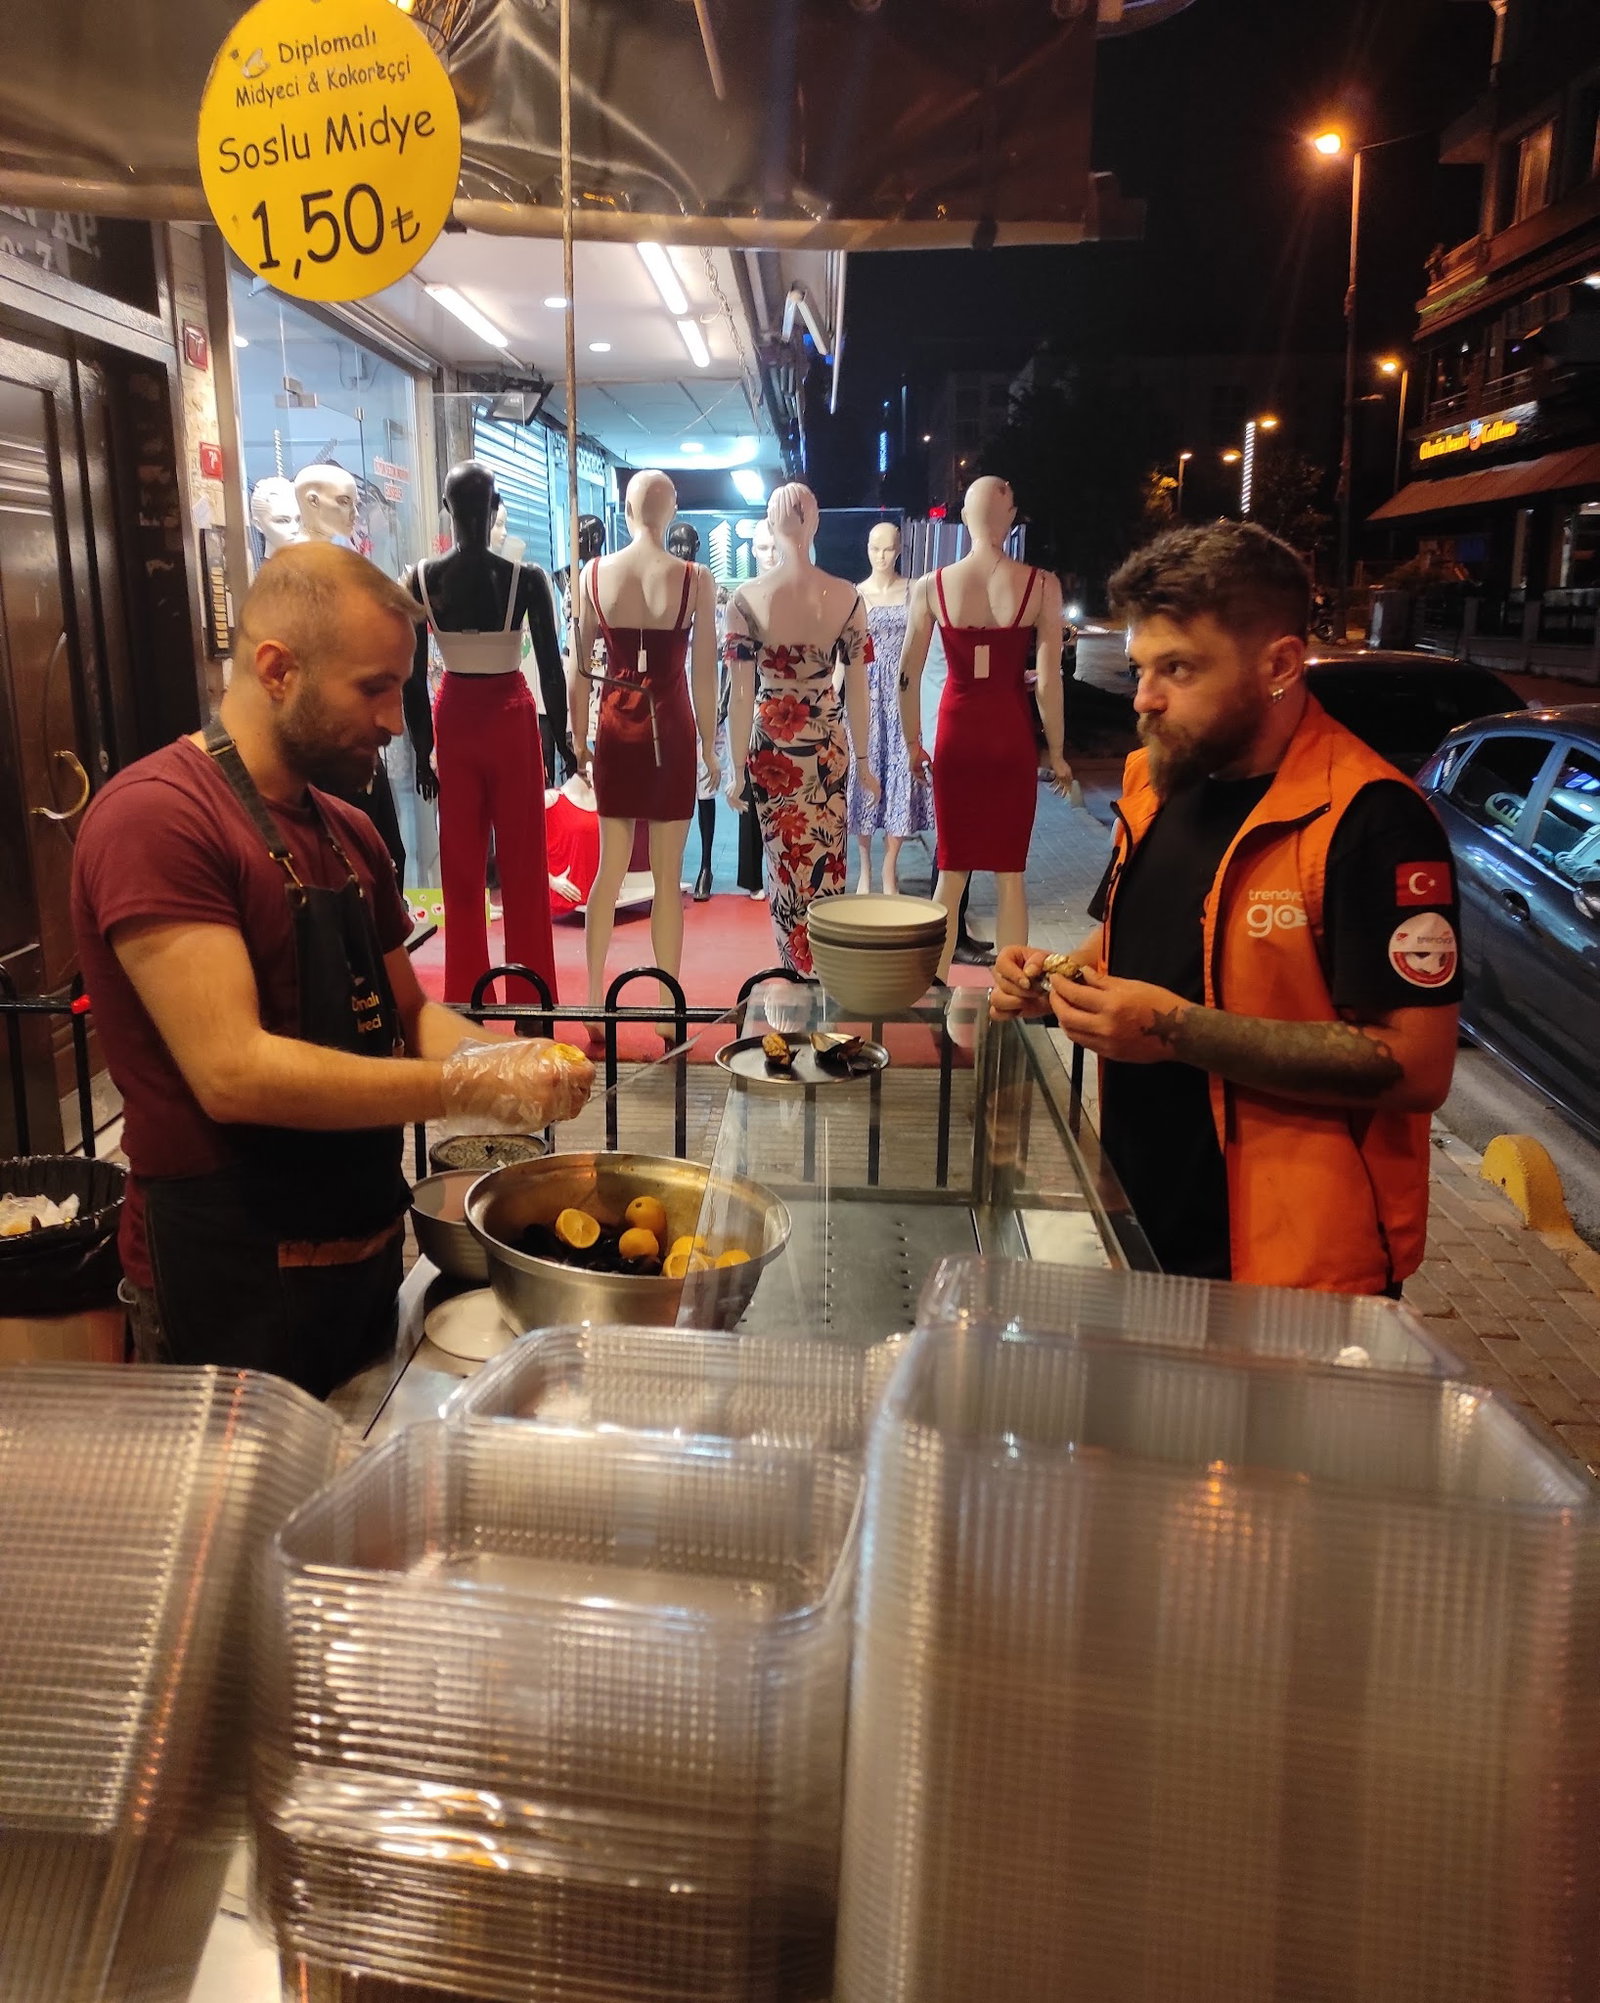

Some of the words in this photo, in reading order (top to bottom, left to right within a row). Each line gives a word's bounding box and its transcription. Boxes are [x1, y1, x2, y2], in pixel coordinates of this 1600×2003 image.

[278, 25, 377, 65] Diplomalı
[236, 81, 301, 108] Midyeci
[308, 72, 320, 94] &
[218, 124, 311, 174] Soslu
[325, 105, 436, 155] Midye
[1248, 888, 1304, 903] trendyo
